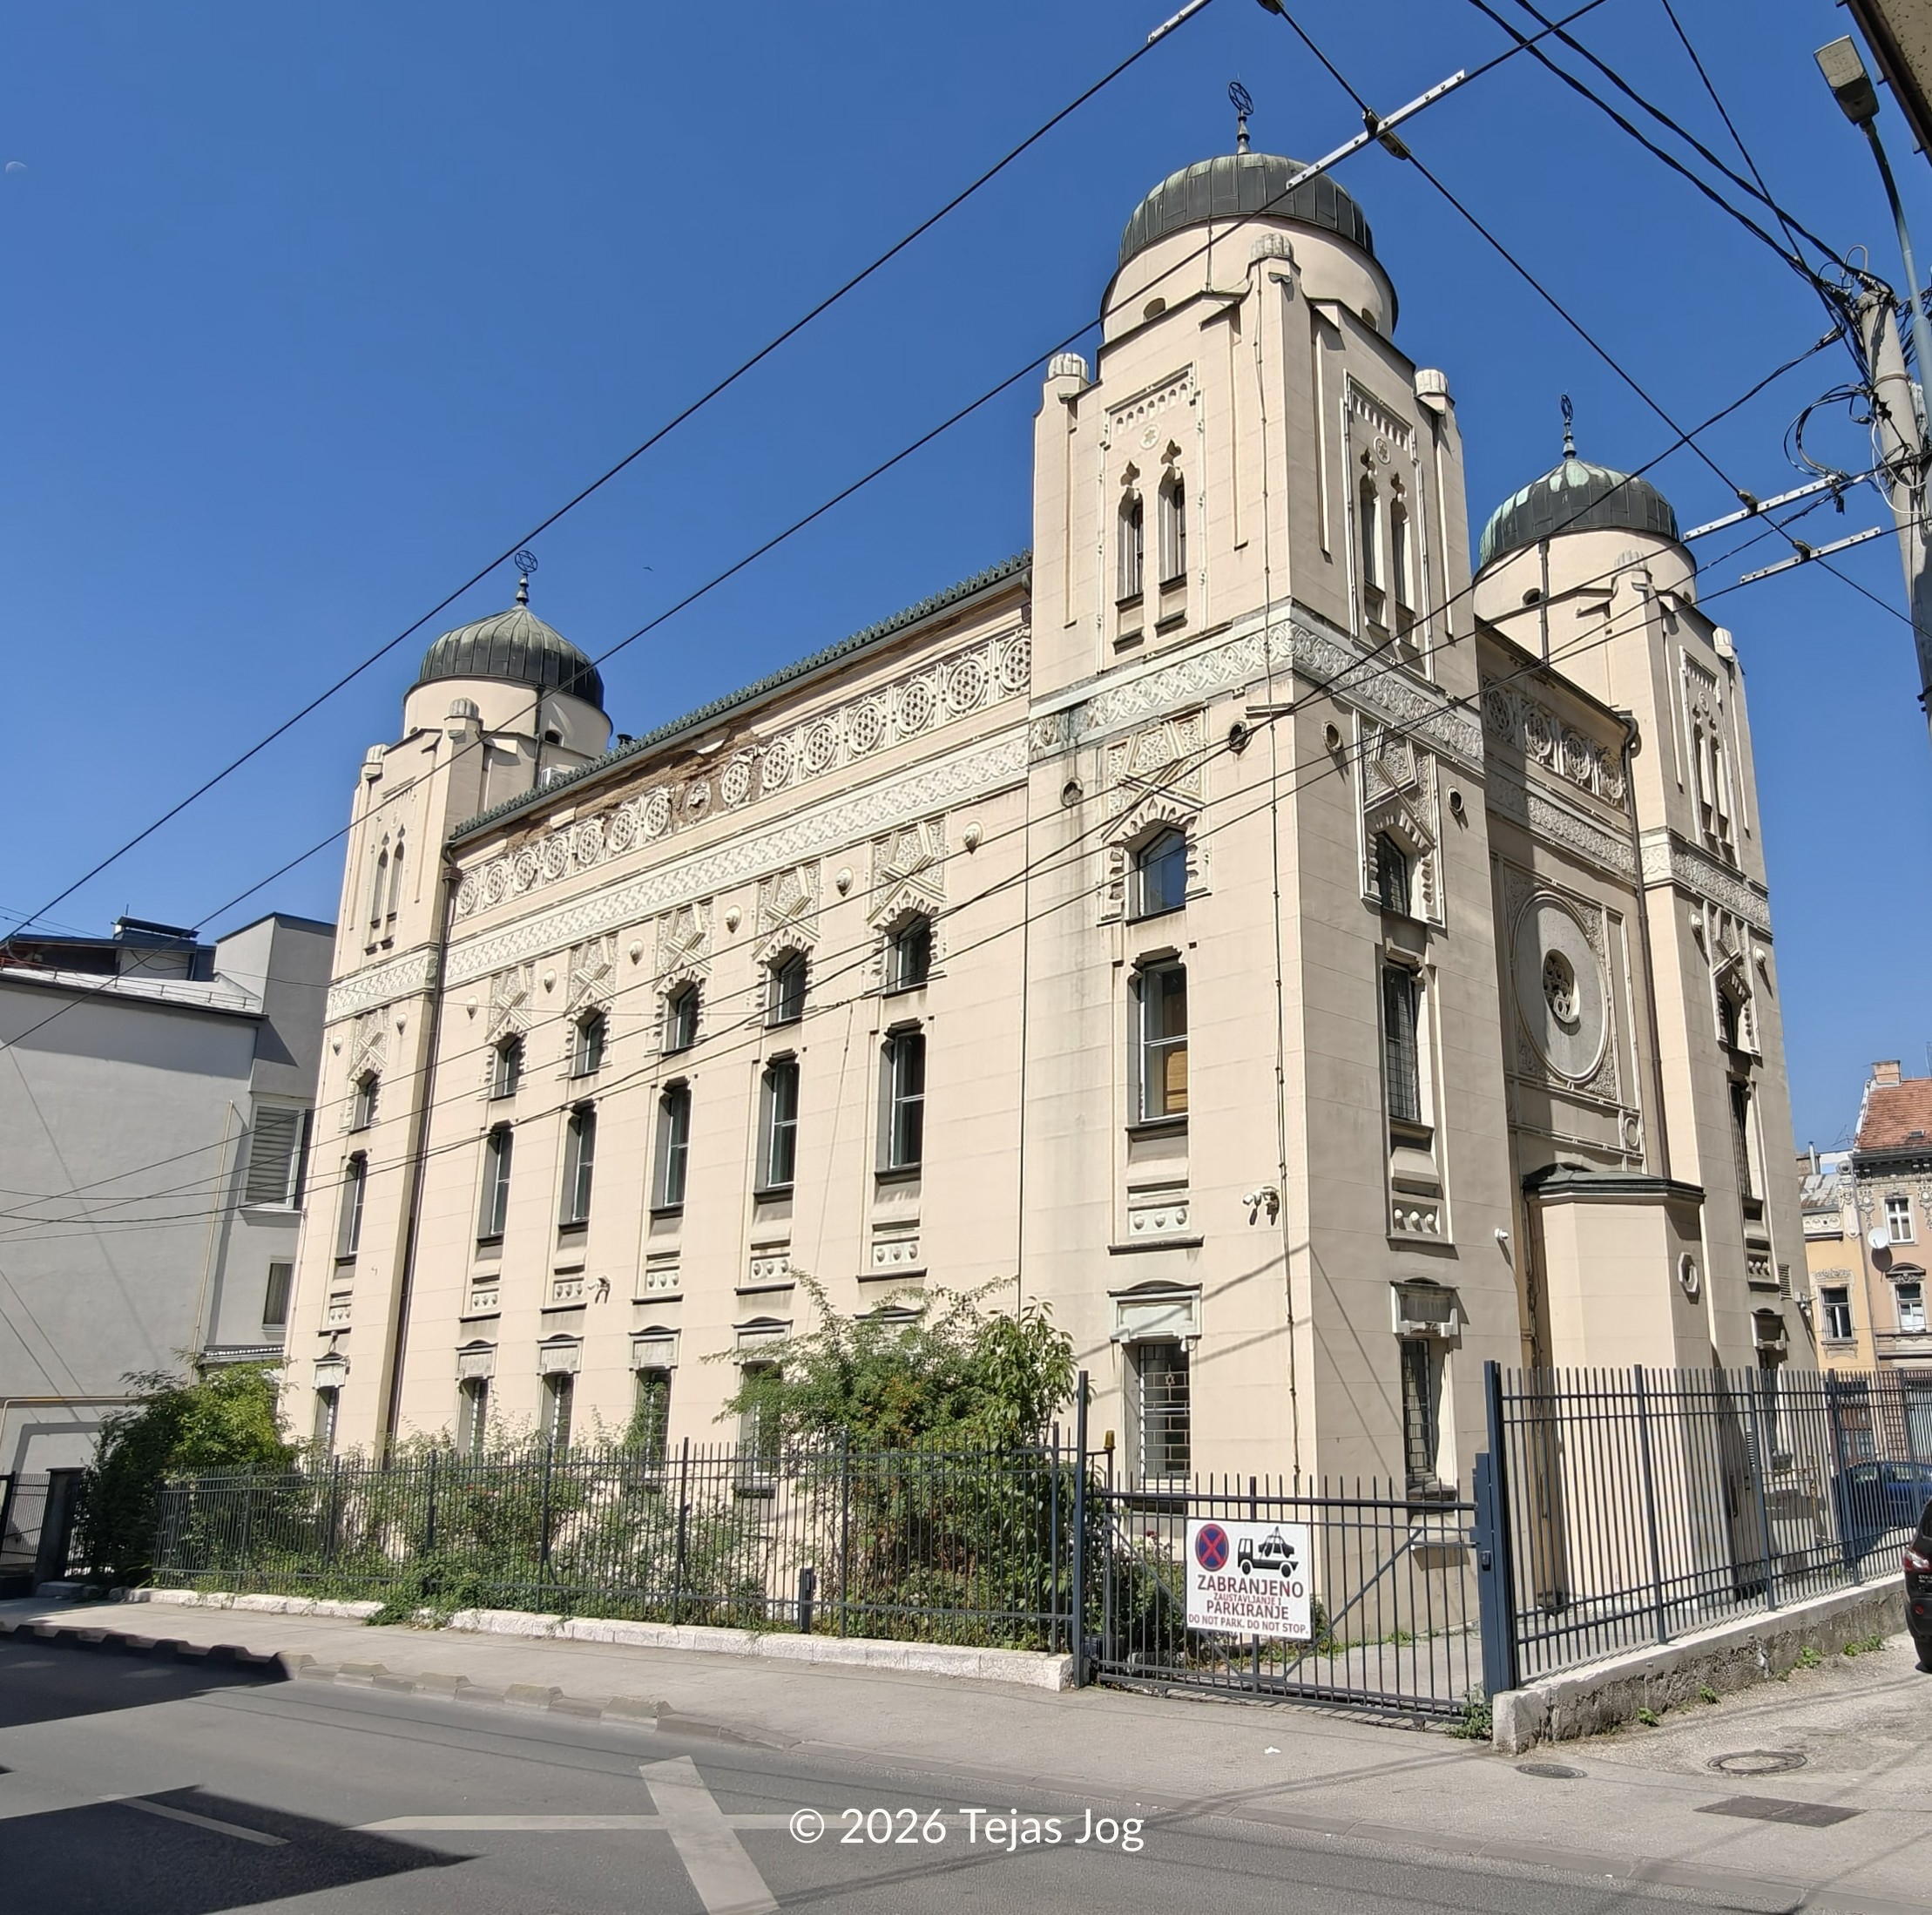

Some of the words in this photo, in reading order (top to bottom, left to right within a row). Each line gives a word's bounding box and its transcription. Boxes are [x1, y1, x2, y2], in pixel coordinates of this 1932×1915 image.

[1198, 1574, 1304, 1598] ZABRANJENO
[1213, 1593, 1276, 1605] ZAUSTAVLJANJE
[1278, 1597, 1281, 1606] I
[1206, 1600, 1289, 1620] PARKIRANJE
[1188, 1614, 1200, 1623] DO
[1202, 1614, 1219, 1626] NOT
[1220, 1617, 1245, 1627] PARK.
[1247, 1620, 1260, 1629] DO
[1262, 1621, 1280, 1632] NOT
[1282, 1623, 1308, 1634] STOP.
